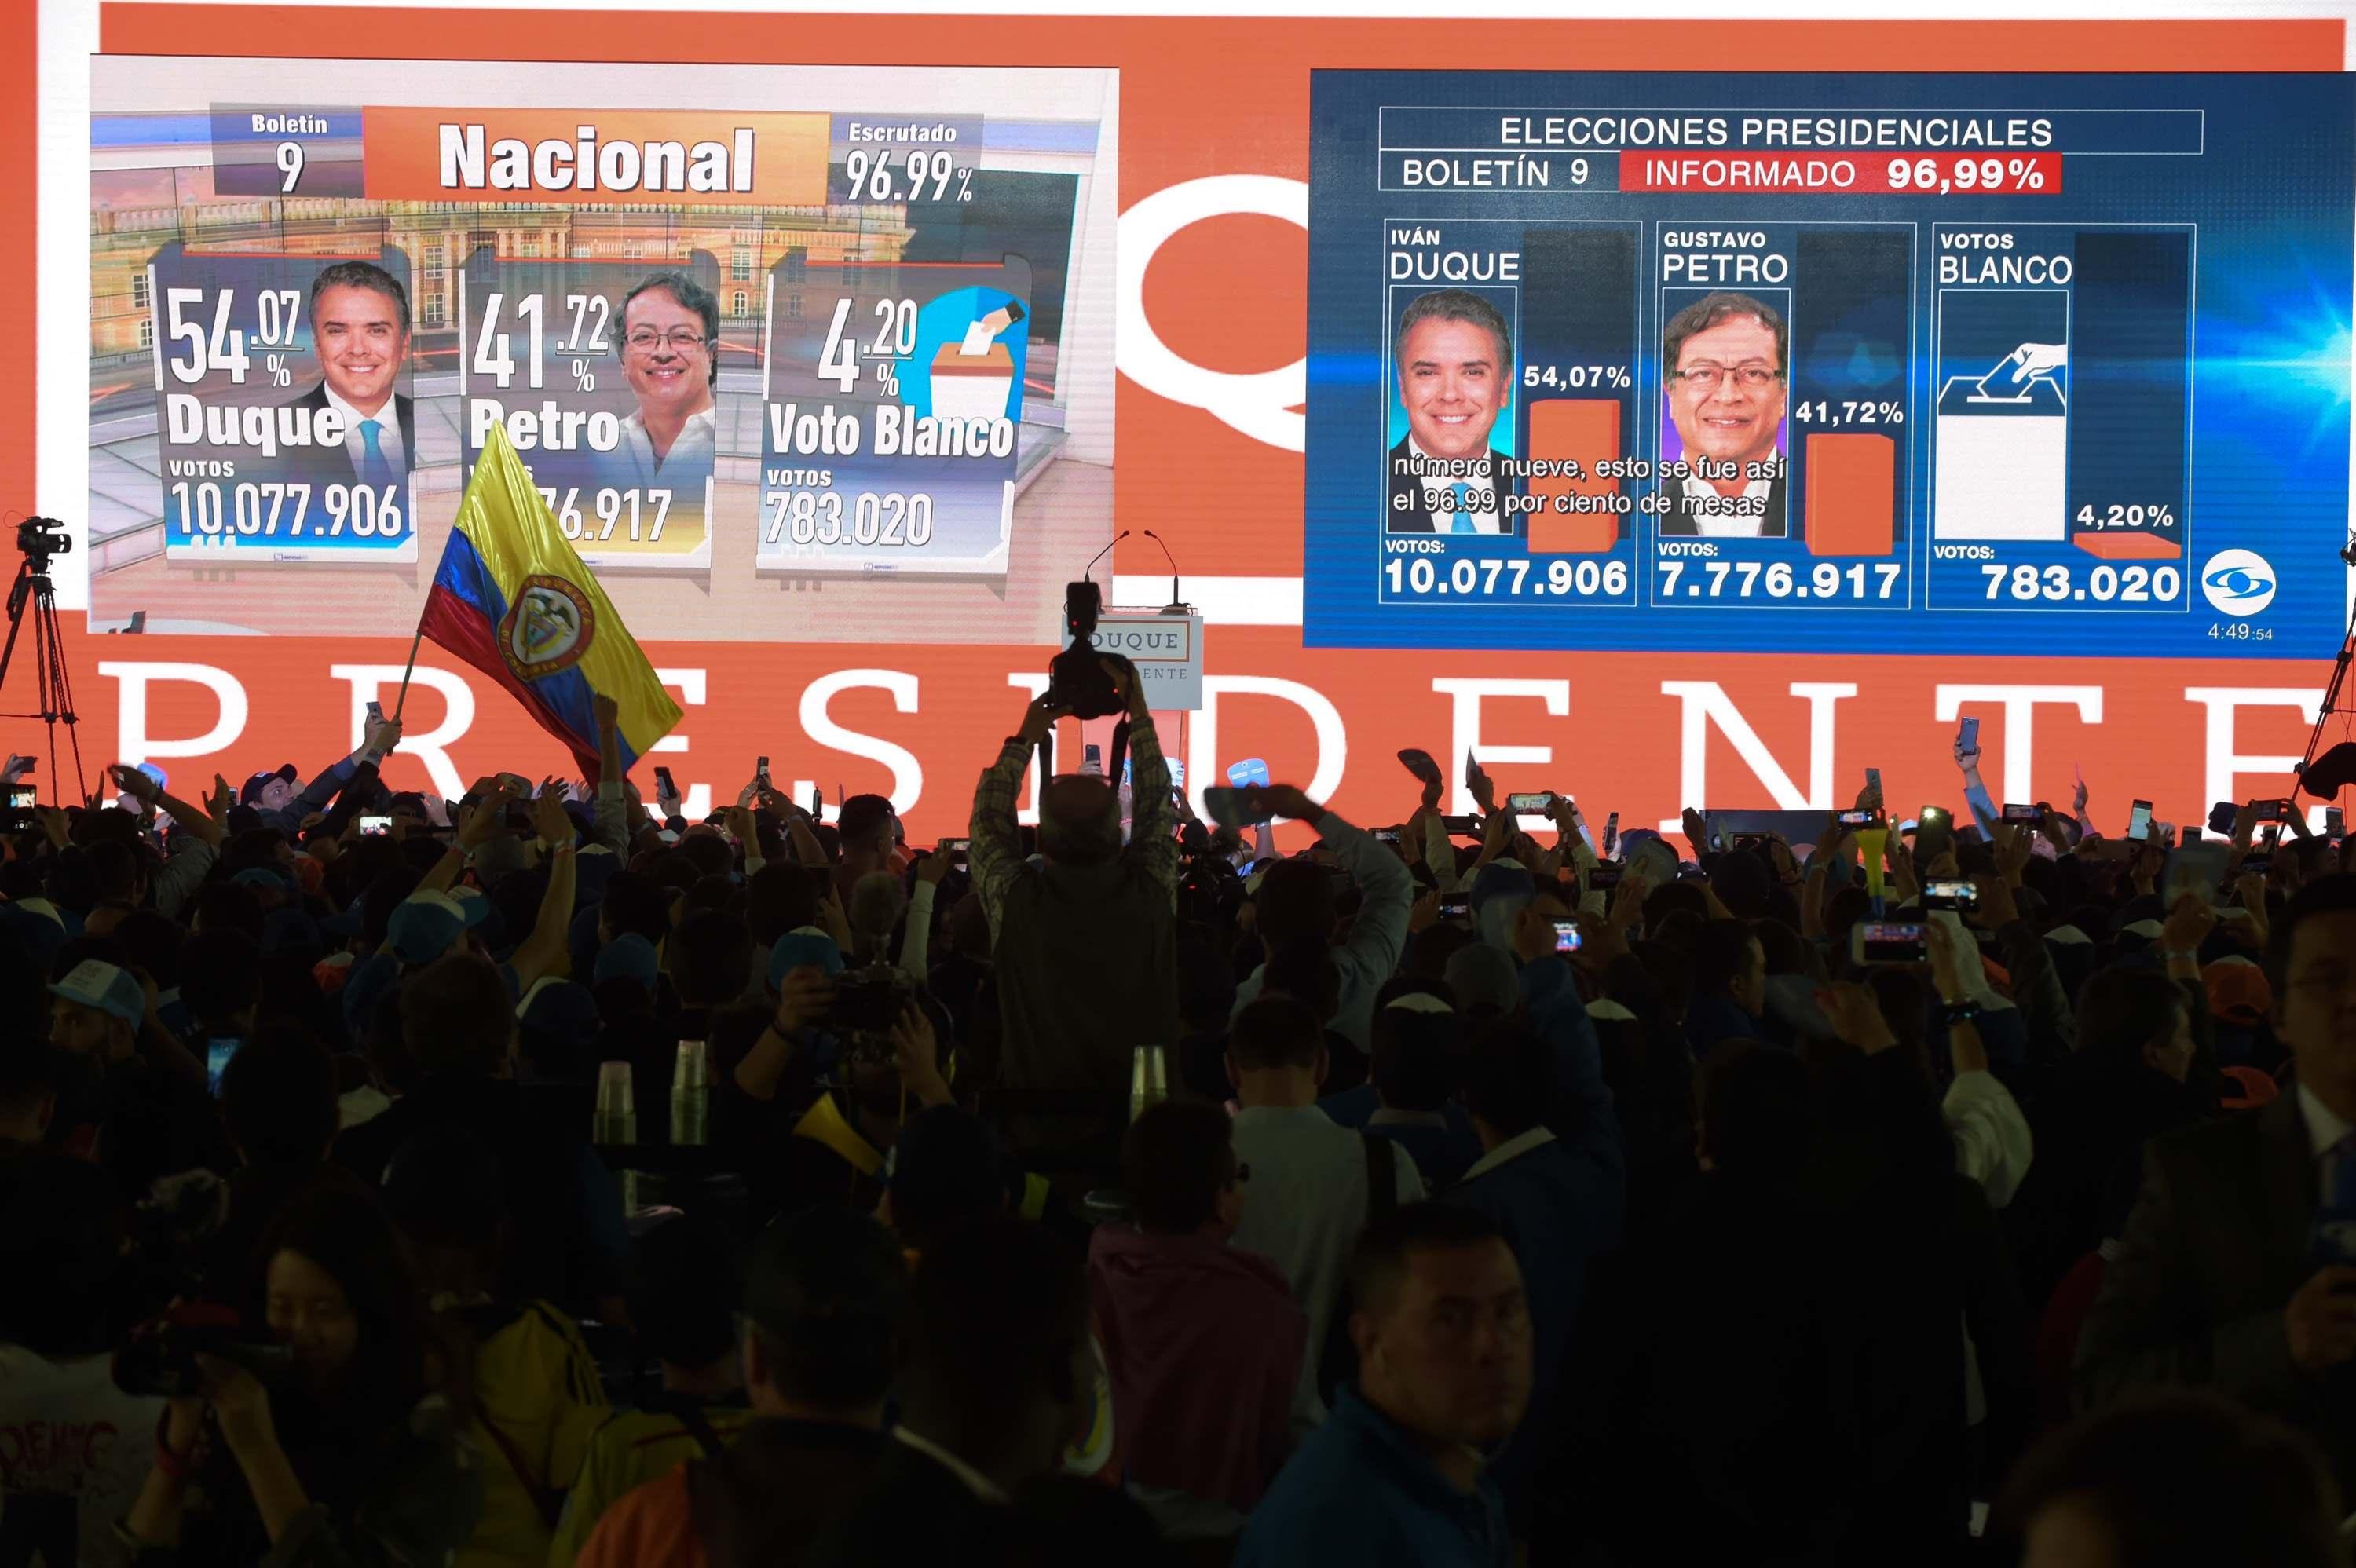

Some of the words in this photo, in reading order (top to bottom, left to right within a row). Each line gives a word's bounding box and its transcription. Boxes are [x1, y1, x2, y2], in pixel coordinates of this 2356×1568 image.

[849, 122, 957, 142] Escrutado
[1502, 118, 1728, 144] ELECCIONES
[1742, 119, 2052, 146] PRESIDENCIALES
[276, 141, 304, 192] 9
[439, 124, 755, 192] Nacional
[846, 150, 973, 202] 96.99%
[1403, 155, 1549, 186] BOLETÍN
[1571, 159, 1589, 185] 9
[1646, 159, 1856, 187] INFORMADO
[1887, 159, 2044, 195] 96,99%
[1391, 227, 1440, 246] IVÁN
[1663, 231, 1766, 248] GUSTAVO
[1940, 233, 2014, 250] VOTOS
[1389, 251, 1520, 281] DUQUE
[1663, 254, 1788, 283] PETRO
[1939, 255, 2072, 284] BLANCO
[1524, 365, 1631, 392] 54,07%
[166, 393, 346, 457] Duque
[470, 398, 620, 451] Petro
[1795, 401, 1904, 427] 41,72%
[769, 402, 861, 455] Voto
[874, 404, 1014, 458] Blanco
[168, 460, 235, 477] VOTOS
[766, 470, 832, 488] VOTOS
[1394, 454, 1491, 477] número
[1501, 460, 1586, 480] nueve,
[1595, 456, 1649, 477] esto
[1659, 462, 1688, 478] se
[1696, 456, 1741, 479] fue
[1747, 456, 1787, 480] así
[170, 481, 402, 538] 10.077.906
[1393, 490, 1414, 510] el
[1424, 489, 1496, 513] 96.99
[1505, 495, 1546, 517] por
[1554, 491, 1632, 513] ciento
[1640, 491, 1672, 513] de
[1681, 493, 1767, 514] mesas
[2077, 504, 2174, 528] 4,20%
[766, 491, 934, 546] 783.020
[1385, 539, 1445, 554] VOTOS:
[1658, 543, 1718, 557] VOTOS:
[1933, 545, 1995, 559] VOTOS:
[1385, 558, 1627, 595] 10.077.906
[1658, 561, 1901, 598] 7.776.917
[1981, 565, 2180, 601] 783.020
